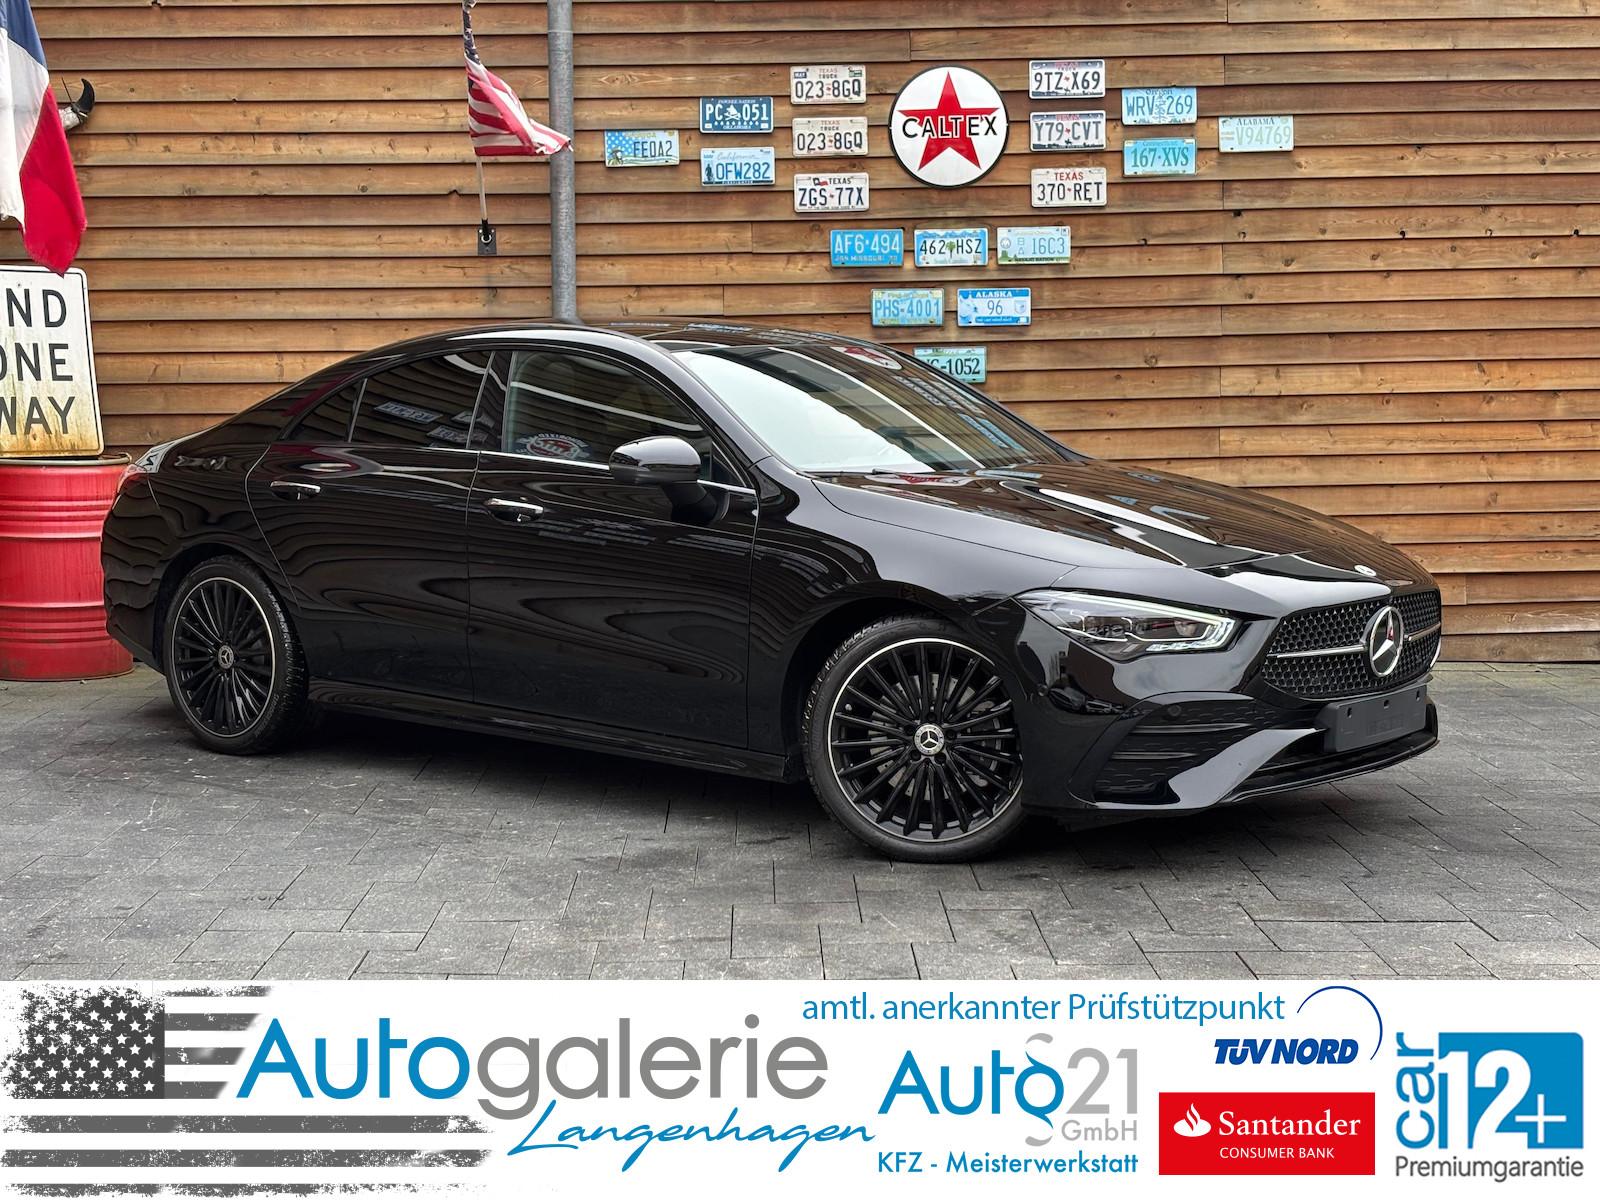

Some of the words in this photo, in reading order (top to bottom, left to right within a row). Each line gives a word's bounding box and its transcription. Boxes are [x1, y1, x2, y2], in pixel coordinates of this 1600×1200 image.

[795, 80, 824, 98] 023
[832, 79, 861, 98] 8GQ
[1034, 72, 1064, 90] 9TZ
[1071, 71, 1100, 90] X69
[706, 104, 724, 120] PC
[742, 104, 768, 120] 051
[1126, 96, 1155, 116] WRV
[1166, 94, 1192, 116] 269
[902, 116, 998, 138] CALTEX
[1034, 122, 1064, 142] Y79
[1072, 121, 1101, 140] CVT
[1236, 118, 1275, 126] ALABAMA
[796, 132, 826, 150] 023
[834, 131, 863, 150] 8GQ
[1236, 126, 1291, 145] V94769
[1054, 172, 1084, 181] TEXAS
[798, 187, 828, 206] ZGS
[835, 186, 864, 206] 77X
[1037, 182, 1065, 201] 370
[1073, 182, 1102, 201] RET
[920, 239, 946, 254] 462
[956, 238, 982, 254] HSZ
[6, 288, 67, 328] ND
[987, 300, 1003, 316] 96
